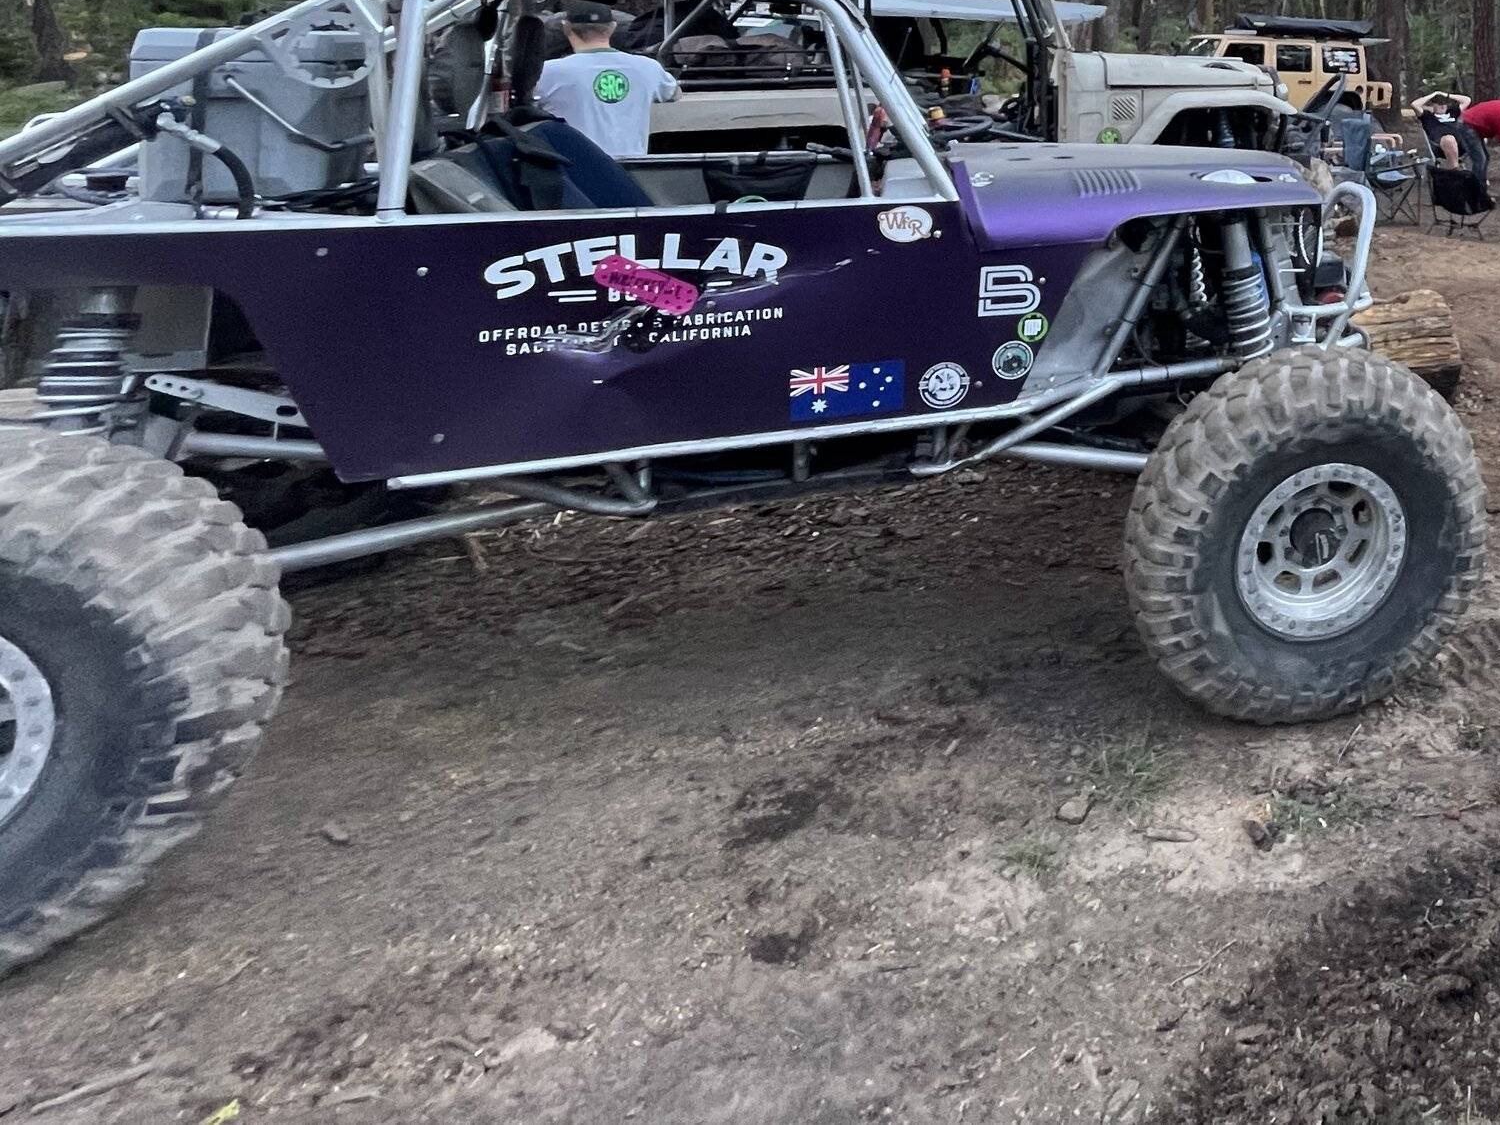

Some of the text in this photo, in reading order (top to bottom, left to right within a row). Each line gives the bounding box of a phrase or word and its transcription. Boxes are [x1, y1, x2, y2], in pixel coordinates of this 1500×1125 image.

[600, 75, 624, 99] SRC
[483, 233, 789, 300] STELLAR
[478, 323, 568, 343] OFFROAD
[648, 324, 752, 344] CALIFORNIA
